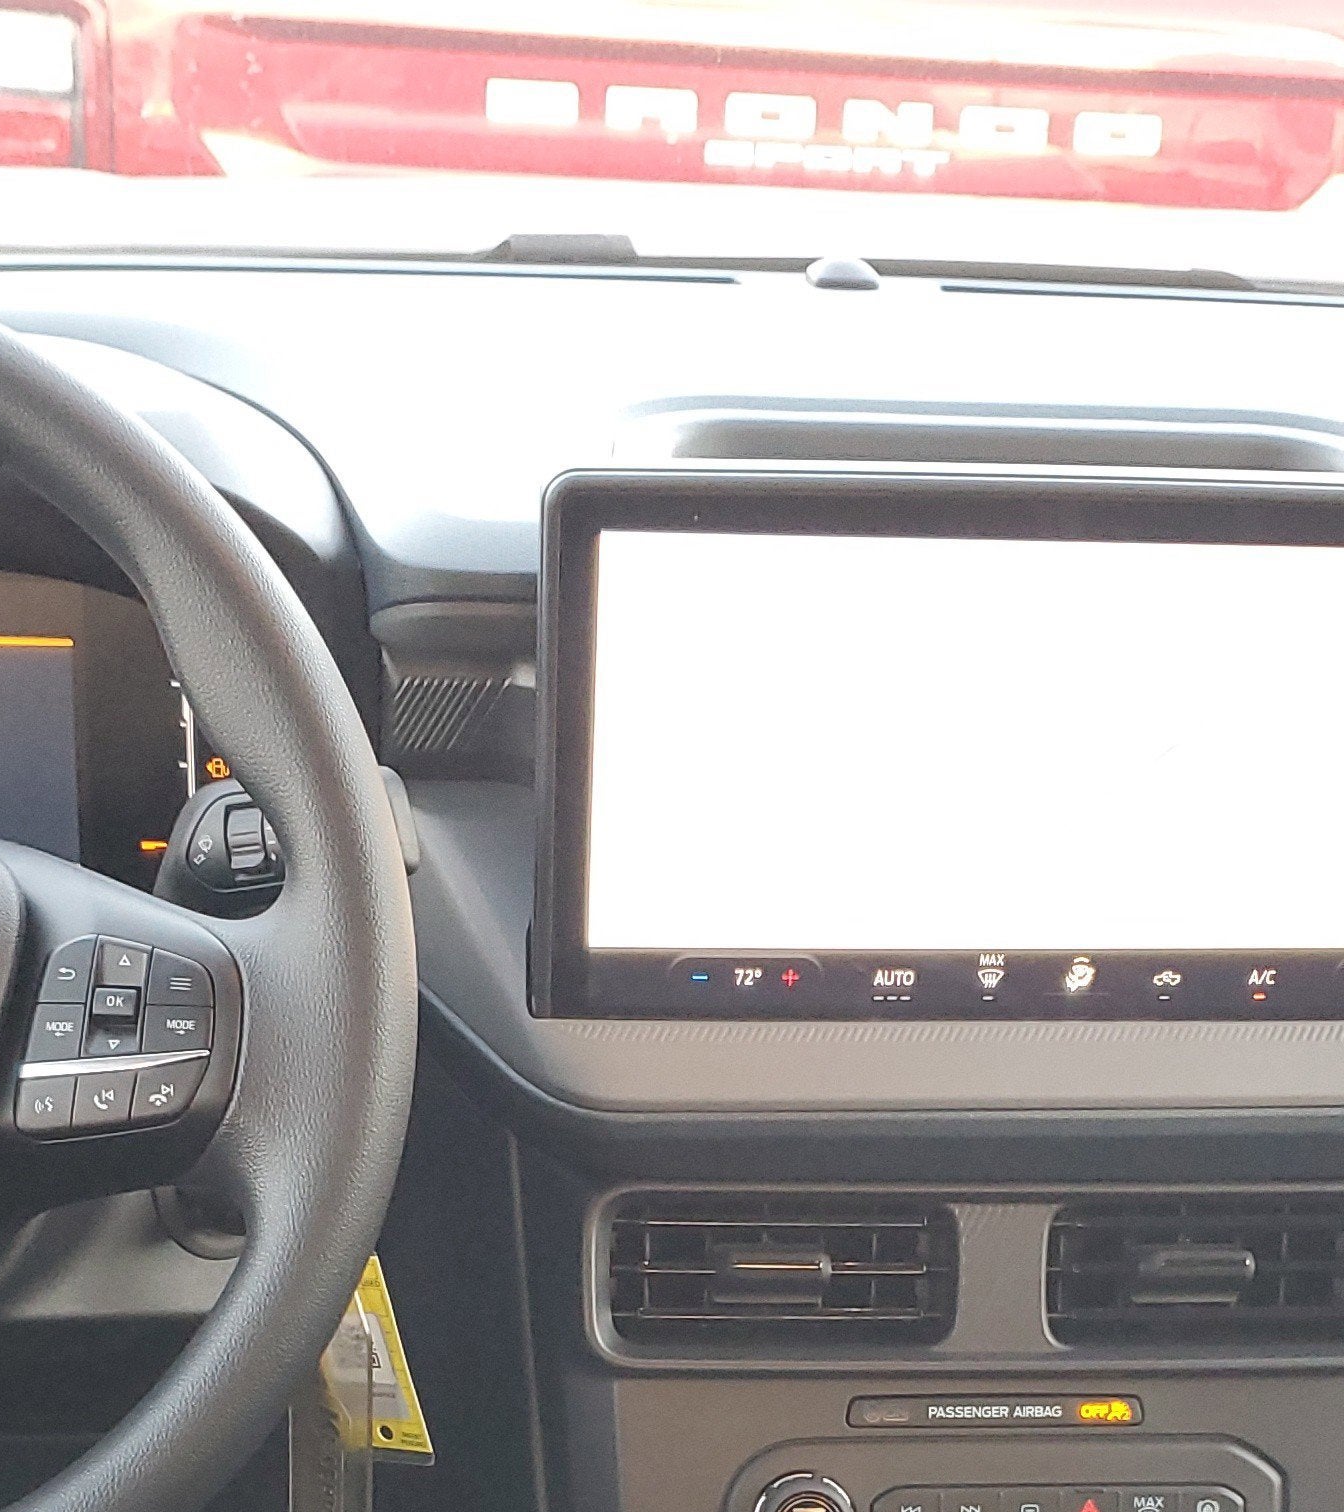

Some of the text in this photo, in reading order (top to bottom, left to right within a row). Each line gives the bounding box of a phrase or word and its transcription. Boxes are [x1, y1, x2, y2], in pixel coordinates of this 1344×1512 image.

[978, 953, 1006, 967] MAX
[873, 969, 915, 987] AUTO
[1248, 968, 1277, 985] A/C
[106, 995, 124, 1008] OK
[45, 1021, 74, 1033] MODE
[166, 1018, 196, 1031] MODE
[927, 1403, 1109, 1420] PASSENGER AIRBAG OFF
[1133, 1496, 1165, 1509] MAX
